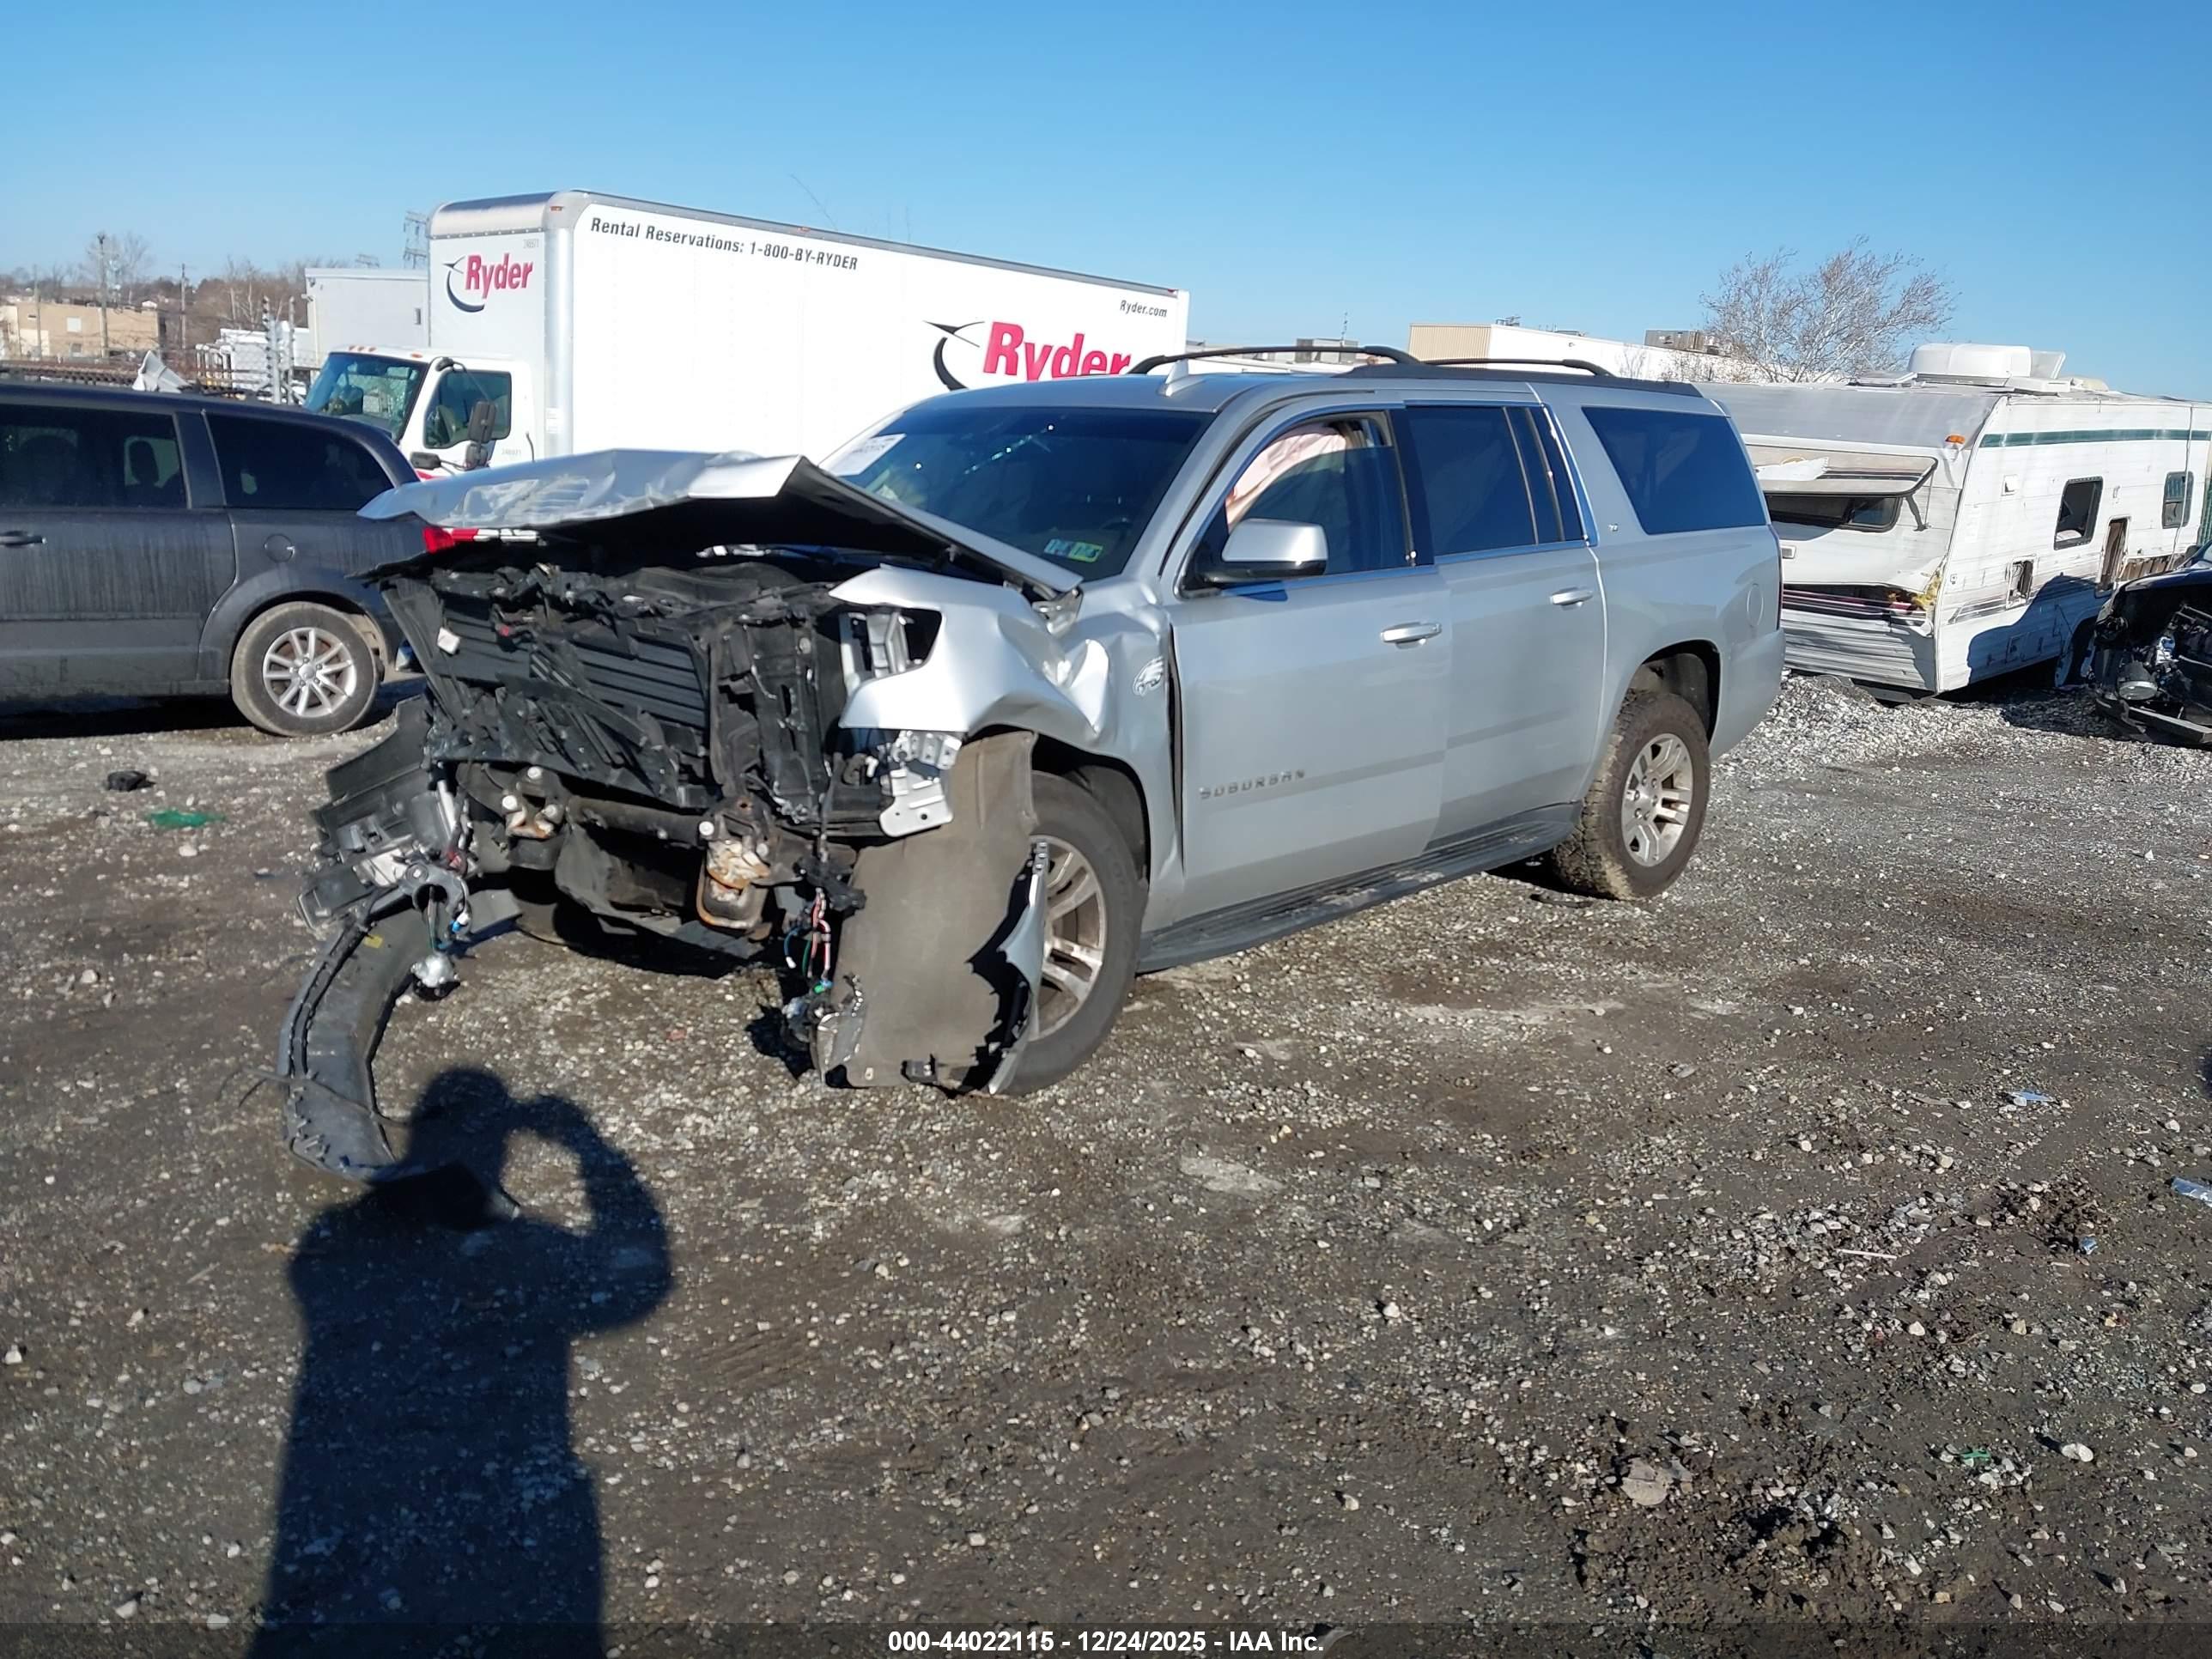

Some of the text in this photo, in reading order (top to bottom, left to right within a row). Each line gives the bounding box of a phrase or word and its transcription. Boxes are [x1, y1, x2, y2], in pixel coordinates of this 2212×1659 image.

[590, 217, 859, 270] Rental Reservations: 1-800-BY-RYDER
[465, 252, 533, 299] Ryder
[1120, 299, 1168, 318] Ryder.com
[983, 321, 1132, 382] Ryder
[1199, 769, 1305, 800] SUBURBAN
